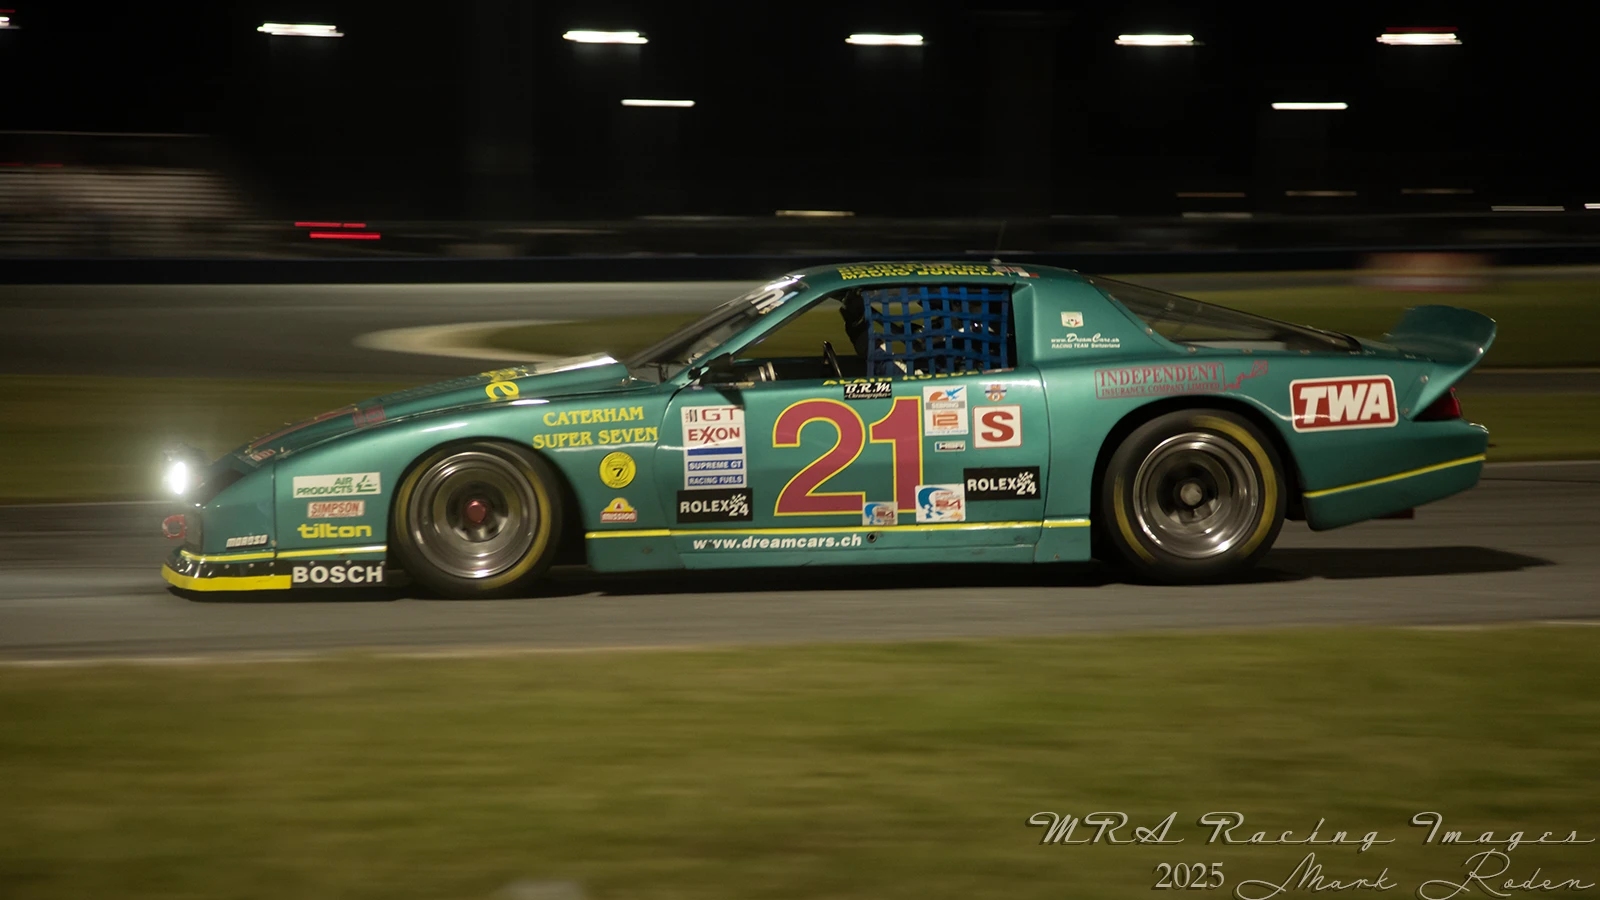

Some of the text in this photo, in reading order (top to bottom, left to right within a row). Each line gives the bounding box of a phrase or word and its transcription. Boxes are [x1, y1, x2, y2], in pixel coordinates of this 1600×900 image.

[1100, 364, 1219, 387] INDEPENDENT
[1101, 381, 1219, 397] INSURANCE COMPANY LIMITED
[1300, 382, 1391, 425] TWA
[543, 406, 645, 427] CATERHAM
[701, 408, 743, 421] GT
[688, 426, 741, 444] EXXON
[981, 411, 1015, 442] S
[532, 426, 659, 449] SUPER SEVEN
[688, 460, 742, 470] SUPREME GT
[772, 396, 923, 516] 21
[334, 476, 354, 485] AIR
[612, 467, 624, 478] 7
[688, 475, 742, 485] RACING FUELS
[296, 485, 353, 496] PRODUCTS
[967, 478, 1037, 496] ROLEX 24
[311, 502, 360, 514] SIMPSON
[679, 499, 750, 517] ROLEX 24
[297, 523, 372, 538] tilton
[292, 565, 383, 583] BOSCH
